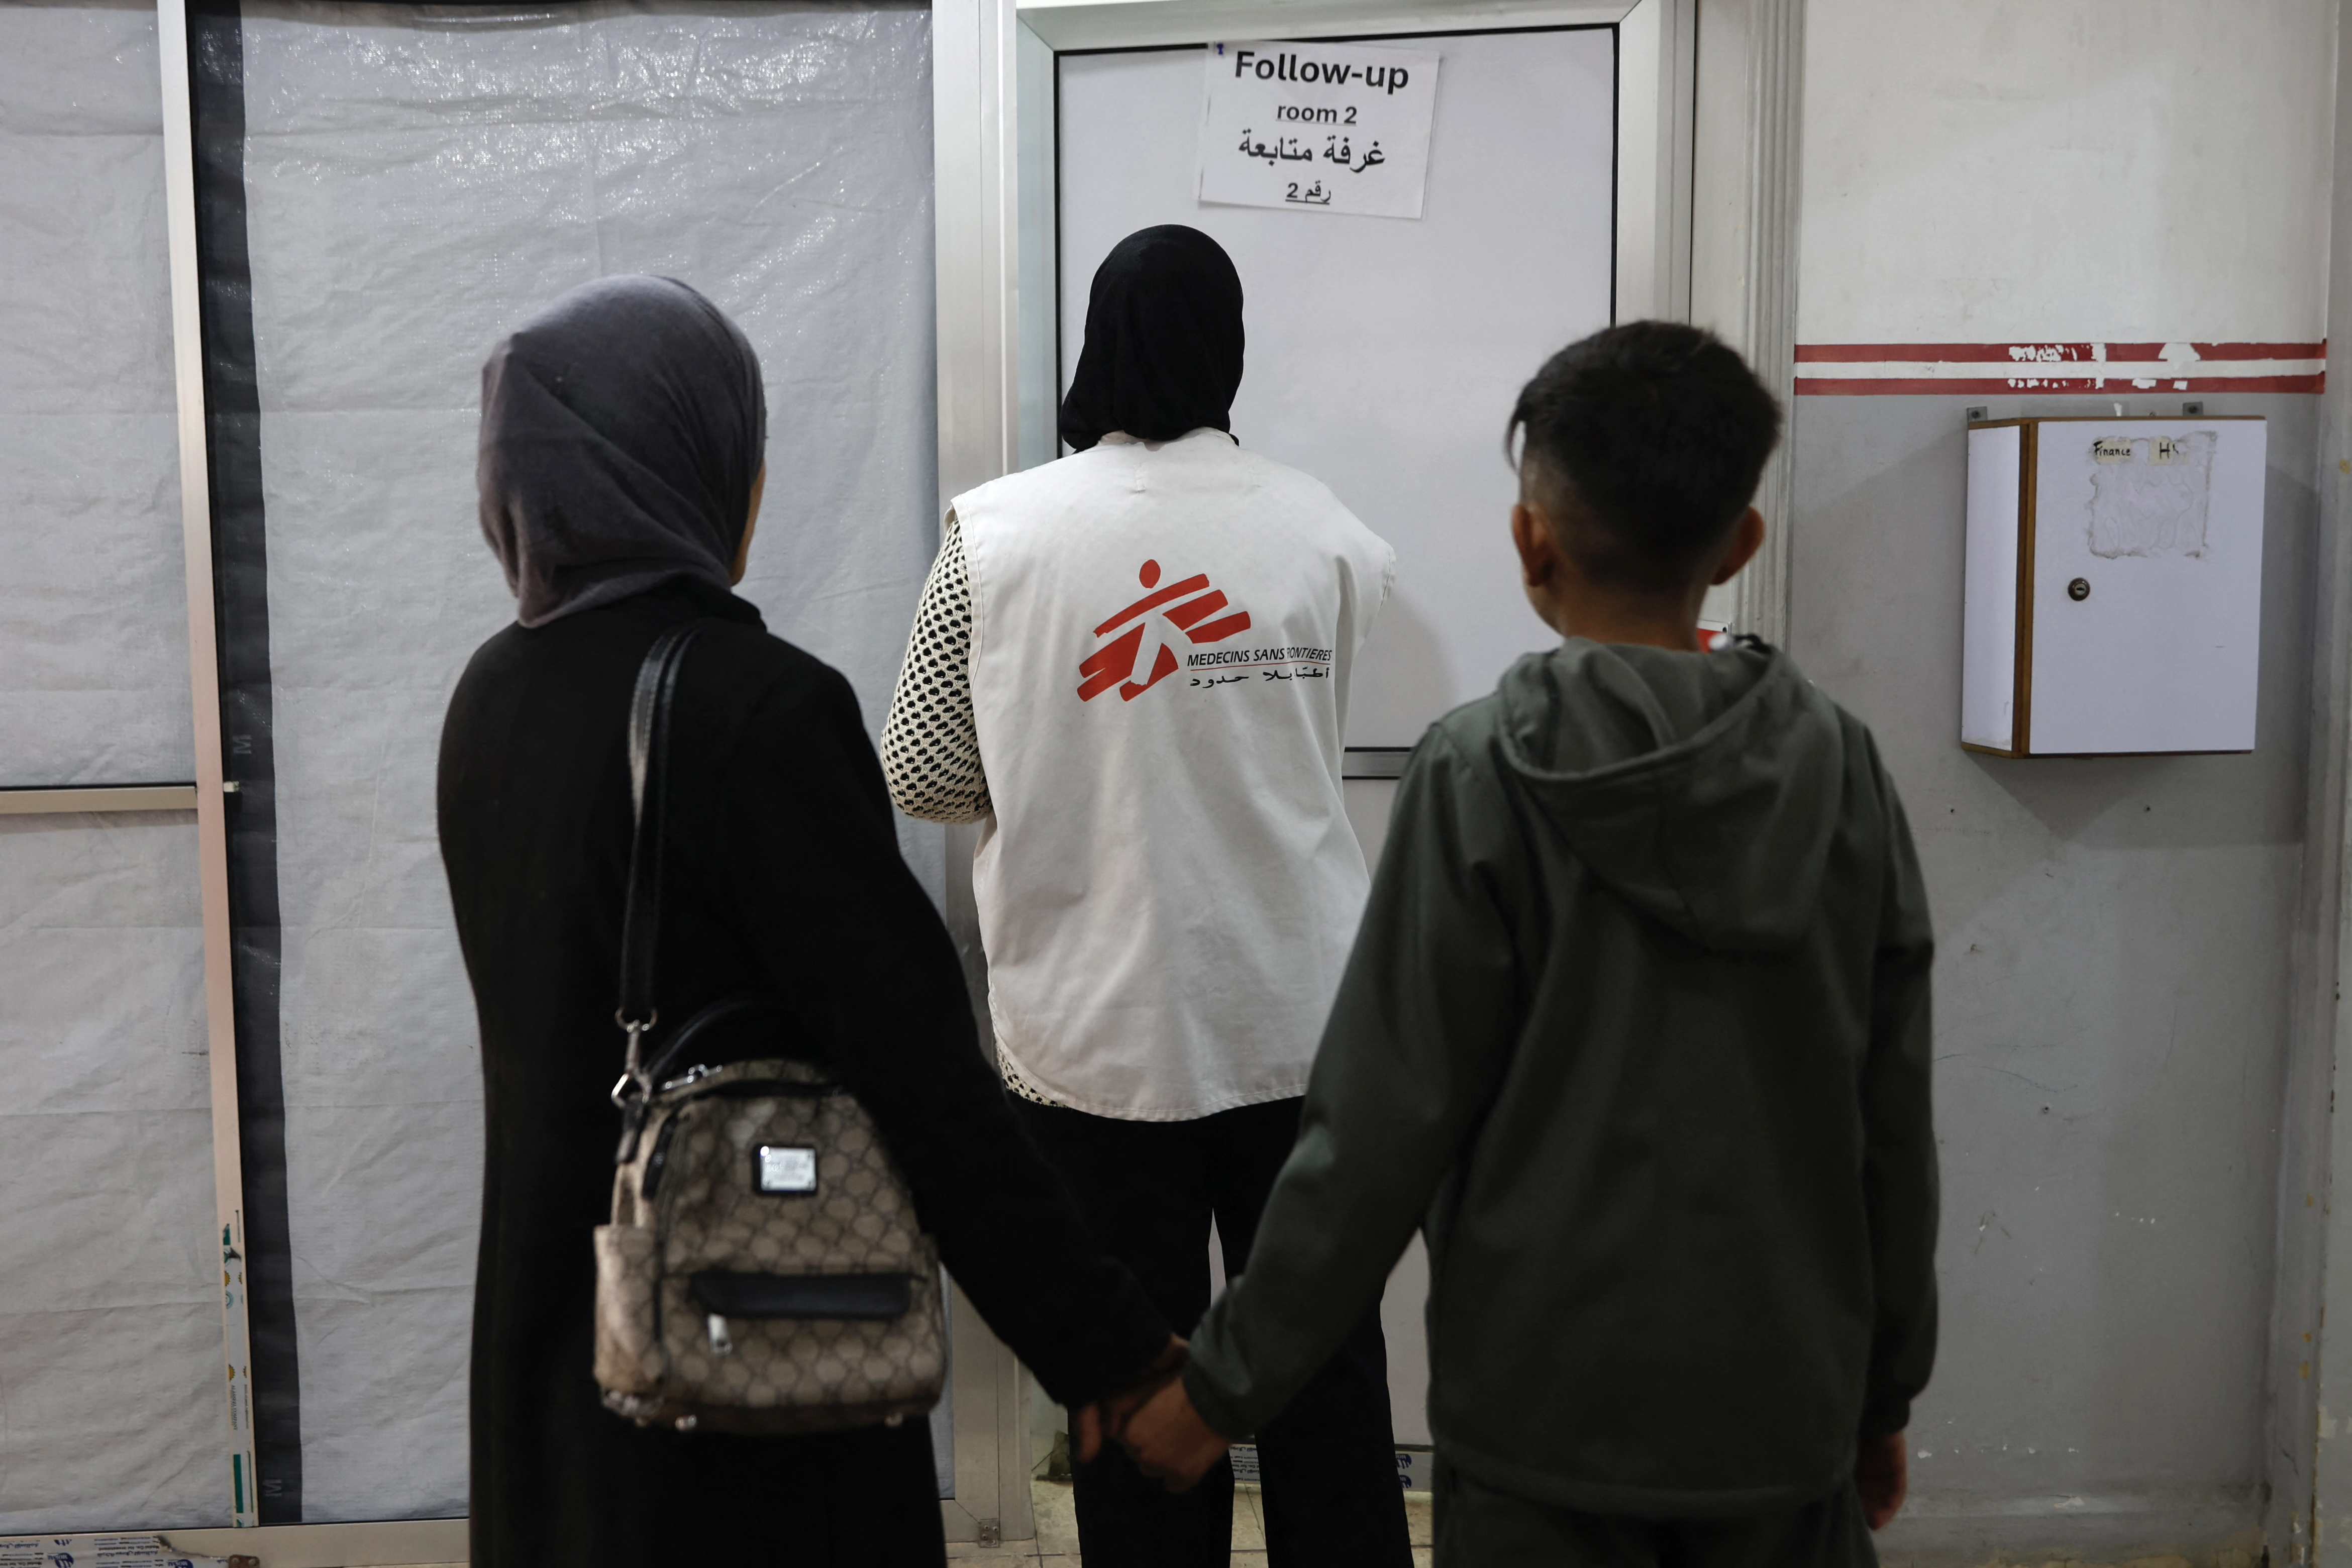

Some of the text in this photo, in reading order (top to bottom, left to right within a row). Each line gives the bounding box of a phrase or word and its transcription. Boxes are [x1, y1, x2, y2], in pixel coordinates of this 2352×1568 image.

[1235, 51, 1409, 95] Follow-up
[1277, 105, 1357, 124] room 2
[1239, 128, 1385, 173] غرفة متابعة
[1286, 180, 1331, 202] رقم 2
[2093, 441, 2131, 456] Finance
[1187, 647, 1333, 666] MEDECINS SANS RONTIERES
[1190, 675, 1249, 688] حدود
